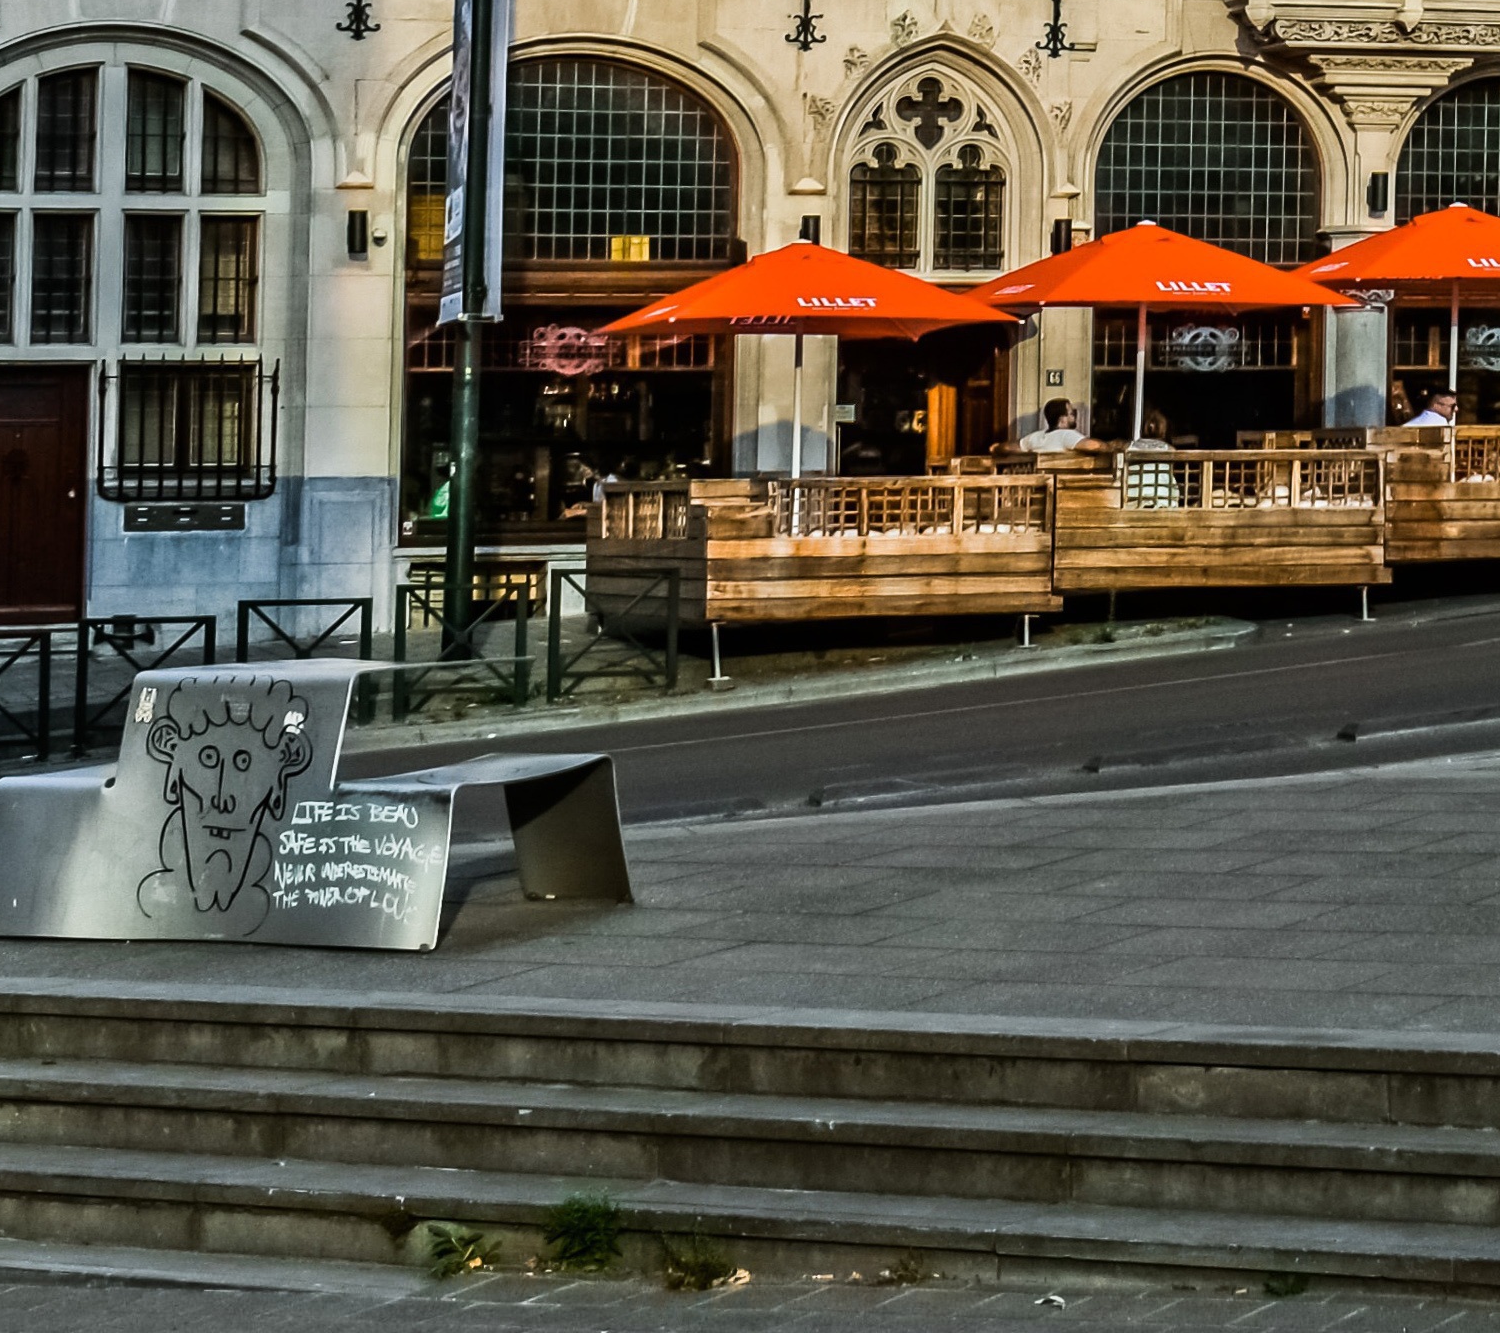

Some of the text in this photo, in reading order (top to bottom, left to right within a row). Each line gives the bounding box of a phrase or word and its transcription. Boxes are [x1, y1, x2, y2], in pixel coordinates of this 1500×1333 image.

[1155, 281, 1232, 292] LILLET
[796, 297, 878, 308] LILLET
[291, 801, 334, 825] LIFE
[335, 804, 363, 821] IS
[279, 830, 317, 855] SAFE
